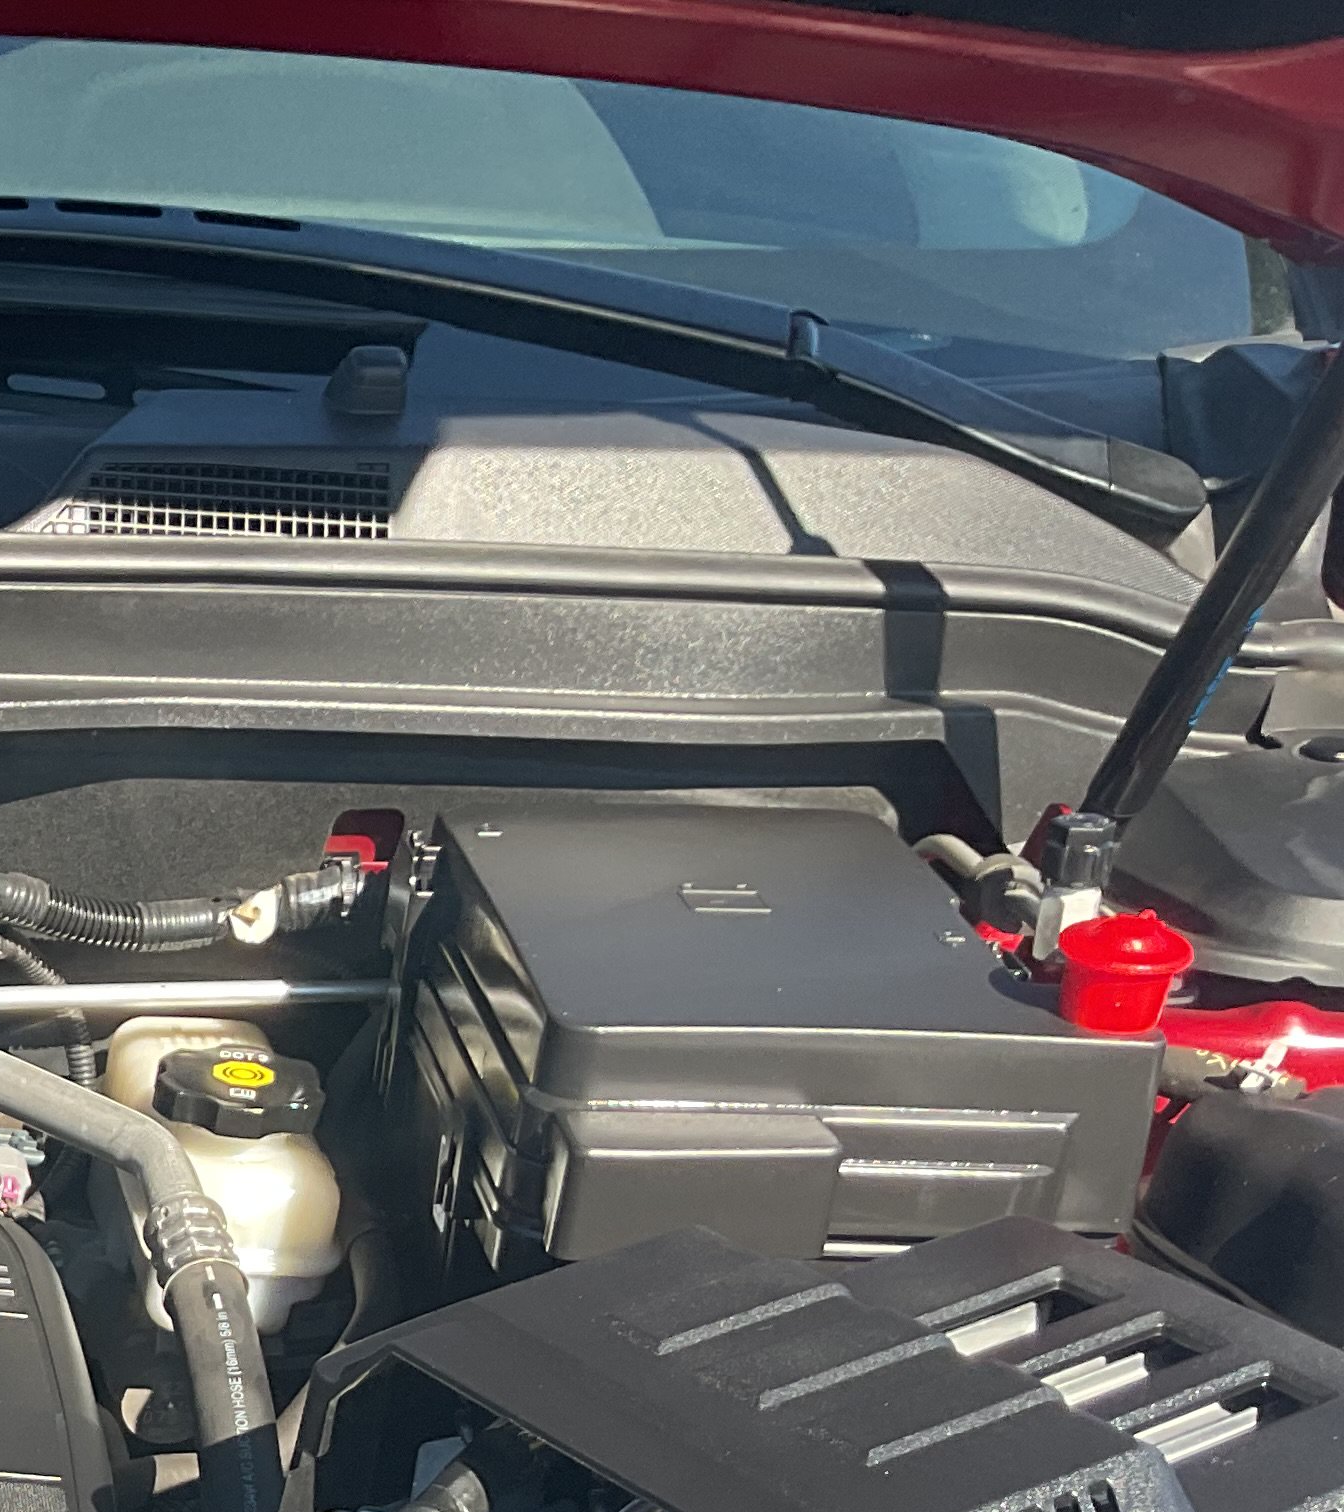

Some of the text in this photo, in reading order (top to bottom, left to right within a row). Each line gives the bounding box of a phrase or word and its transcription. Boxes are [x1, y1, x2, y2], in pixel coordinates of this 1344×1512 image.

[219, 1050, 254, 1061] DOT
[216, 1311, 228, 1320] in
[221, 1339, 242, 1375] (16mm)
[228, 1376, 246, 1409] HOSE
